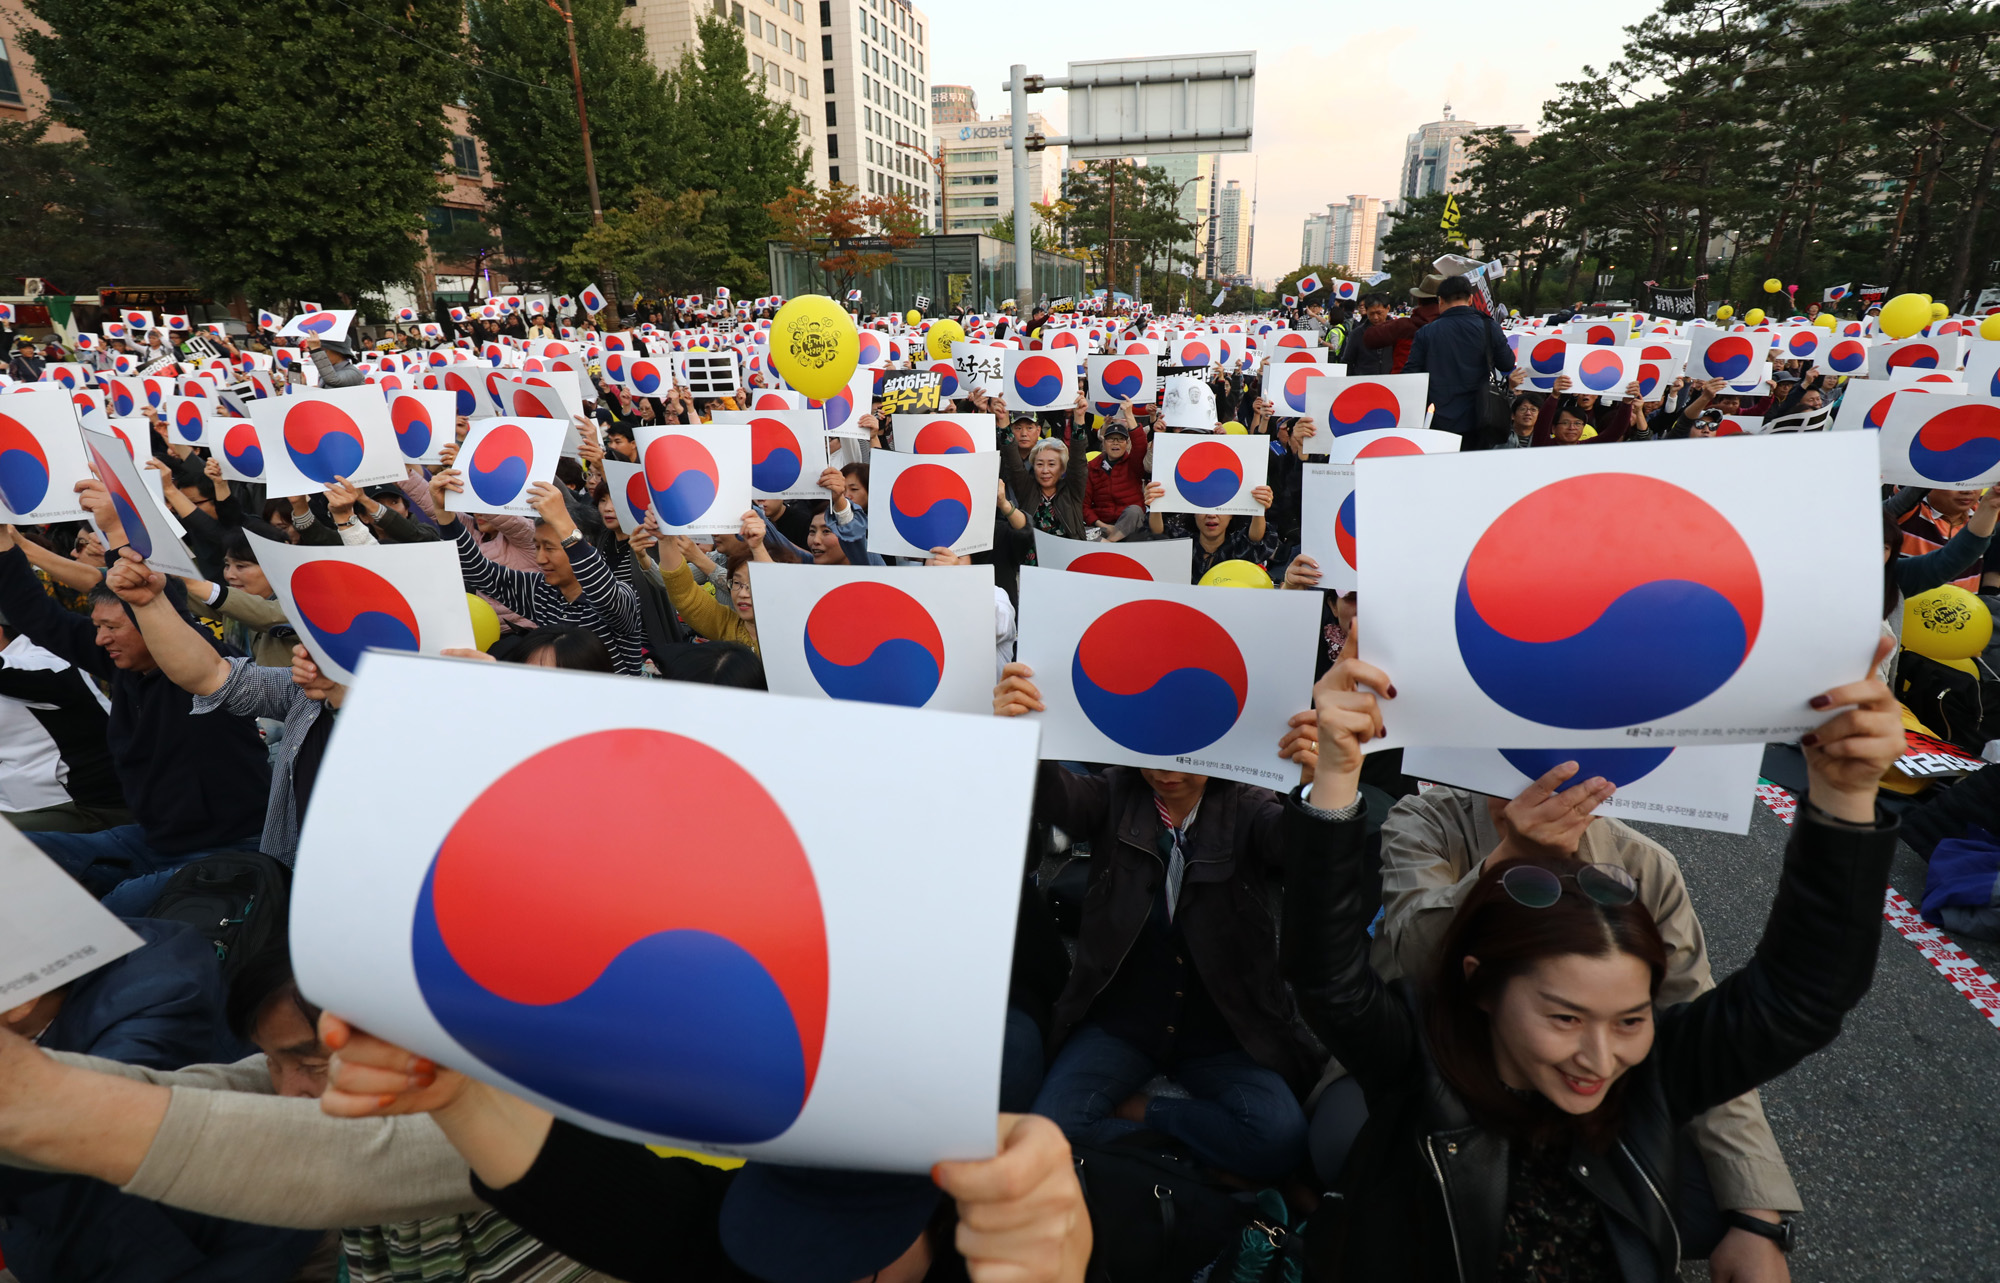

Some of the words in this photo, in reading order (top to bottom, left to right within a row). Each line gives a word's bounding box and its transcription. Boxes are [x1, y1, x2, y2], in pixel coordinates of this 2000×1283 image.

[955, 354, 1003, 384] 조국수호
[884, 372, 942, 393] 설치하라!
[881, 385, 941, 416] 공수처
[1626, 727, 1652, 737] 태극
[1176, 756, 1192, 765] 태극
[1192, 758, 1206, 767] 음과
[1206, 760, 1219, 769] 양의
[1219, 762, 1234, 772] 조화,
[1234, 765, 1259, 776] 우주만물
[1259, 769, 1285, 783] 상호작용
[1614, 798, 1631, 808] 음과
[1631, 800, 1646, 810] 양의
[1647, 802, 1665, 813] 조화,
[1665, 805, 1696, 817] 우주만물
[1697, 809, 1729, 822] 상호작용
[1896, 915, 1929, 934] 위험
[1947, 966, 2000, 1009] 안전제일
